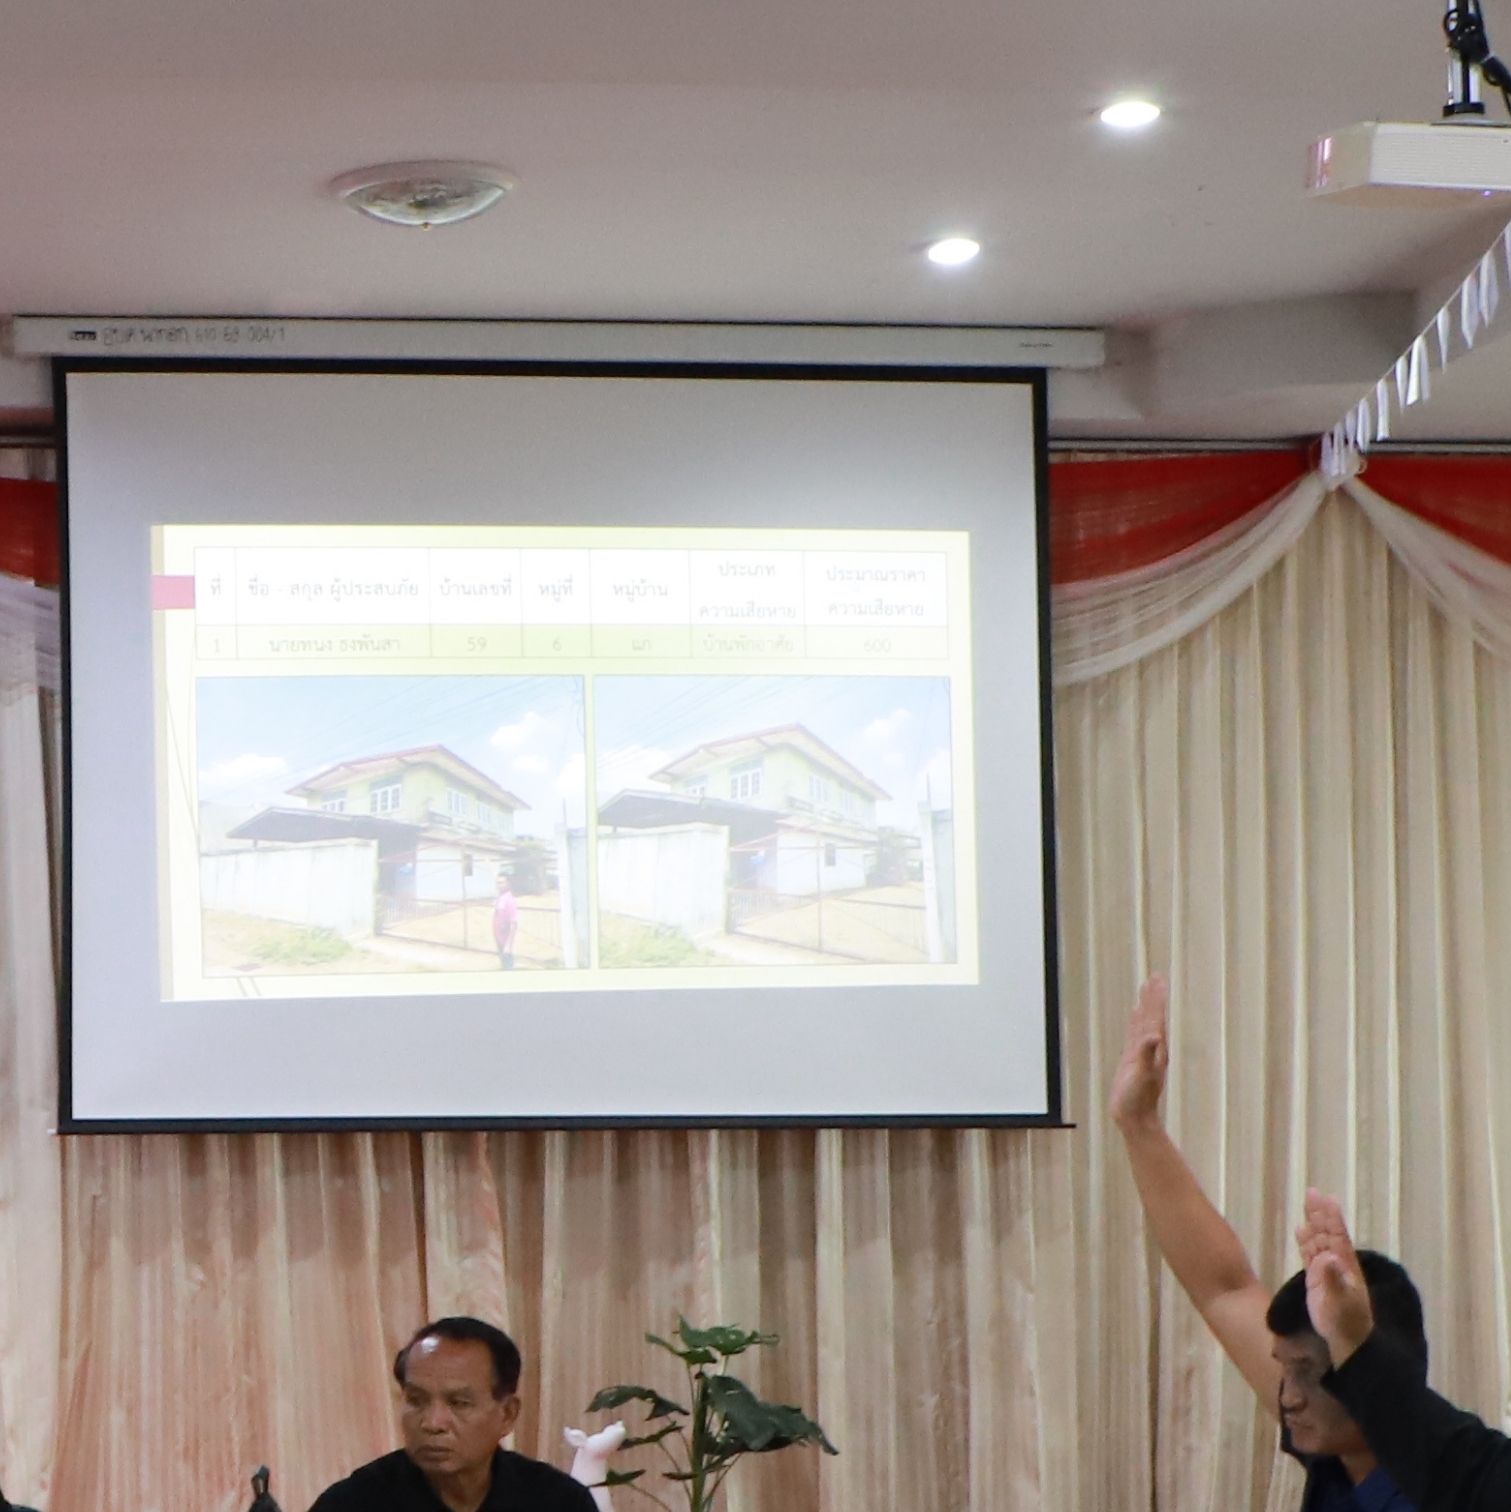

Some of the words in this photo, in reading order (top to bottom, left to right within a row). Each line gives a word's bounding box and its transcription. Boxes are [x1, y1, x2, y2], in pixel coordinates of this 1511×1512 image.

[825, 566, 926, 583] ประมาณราคา
[466, 637, 487, 652] 59
[863, 638, 891, 652] 600
